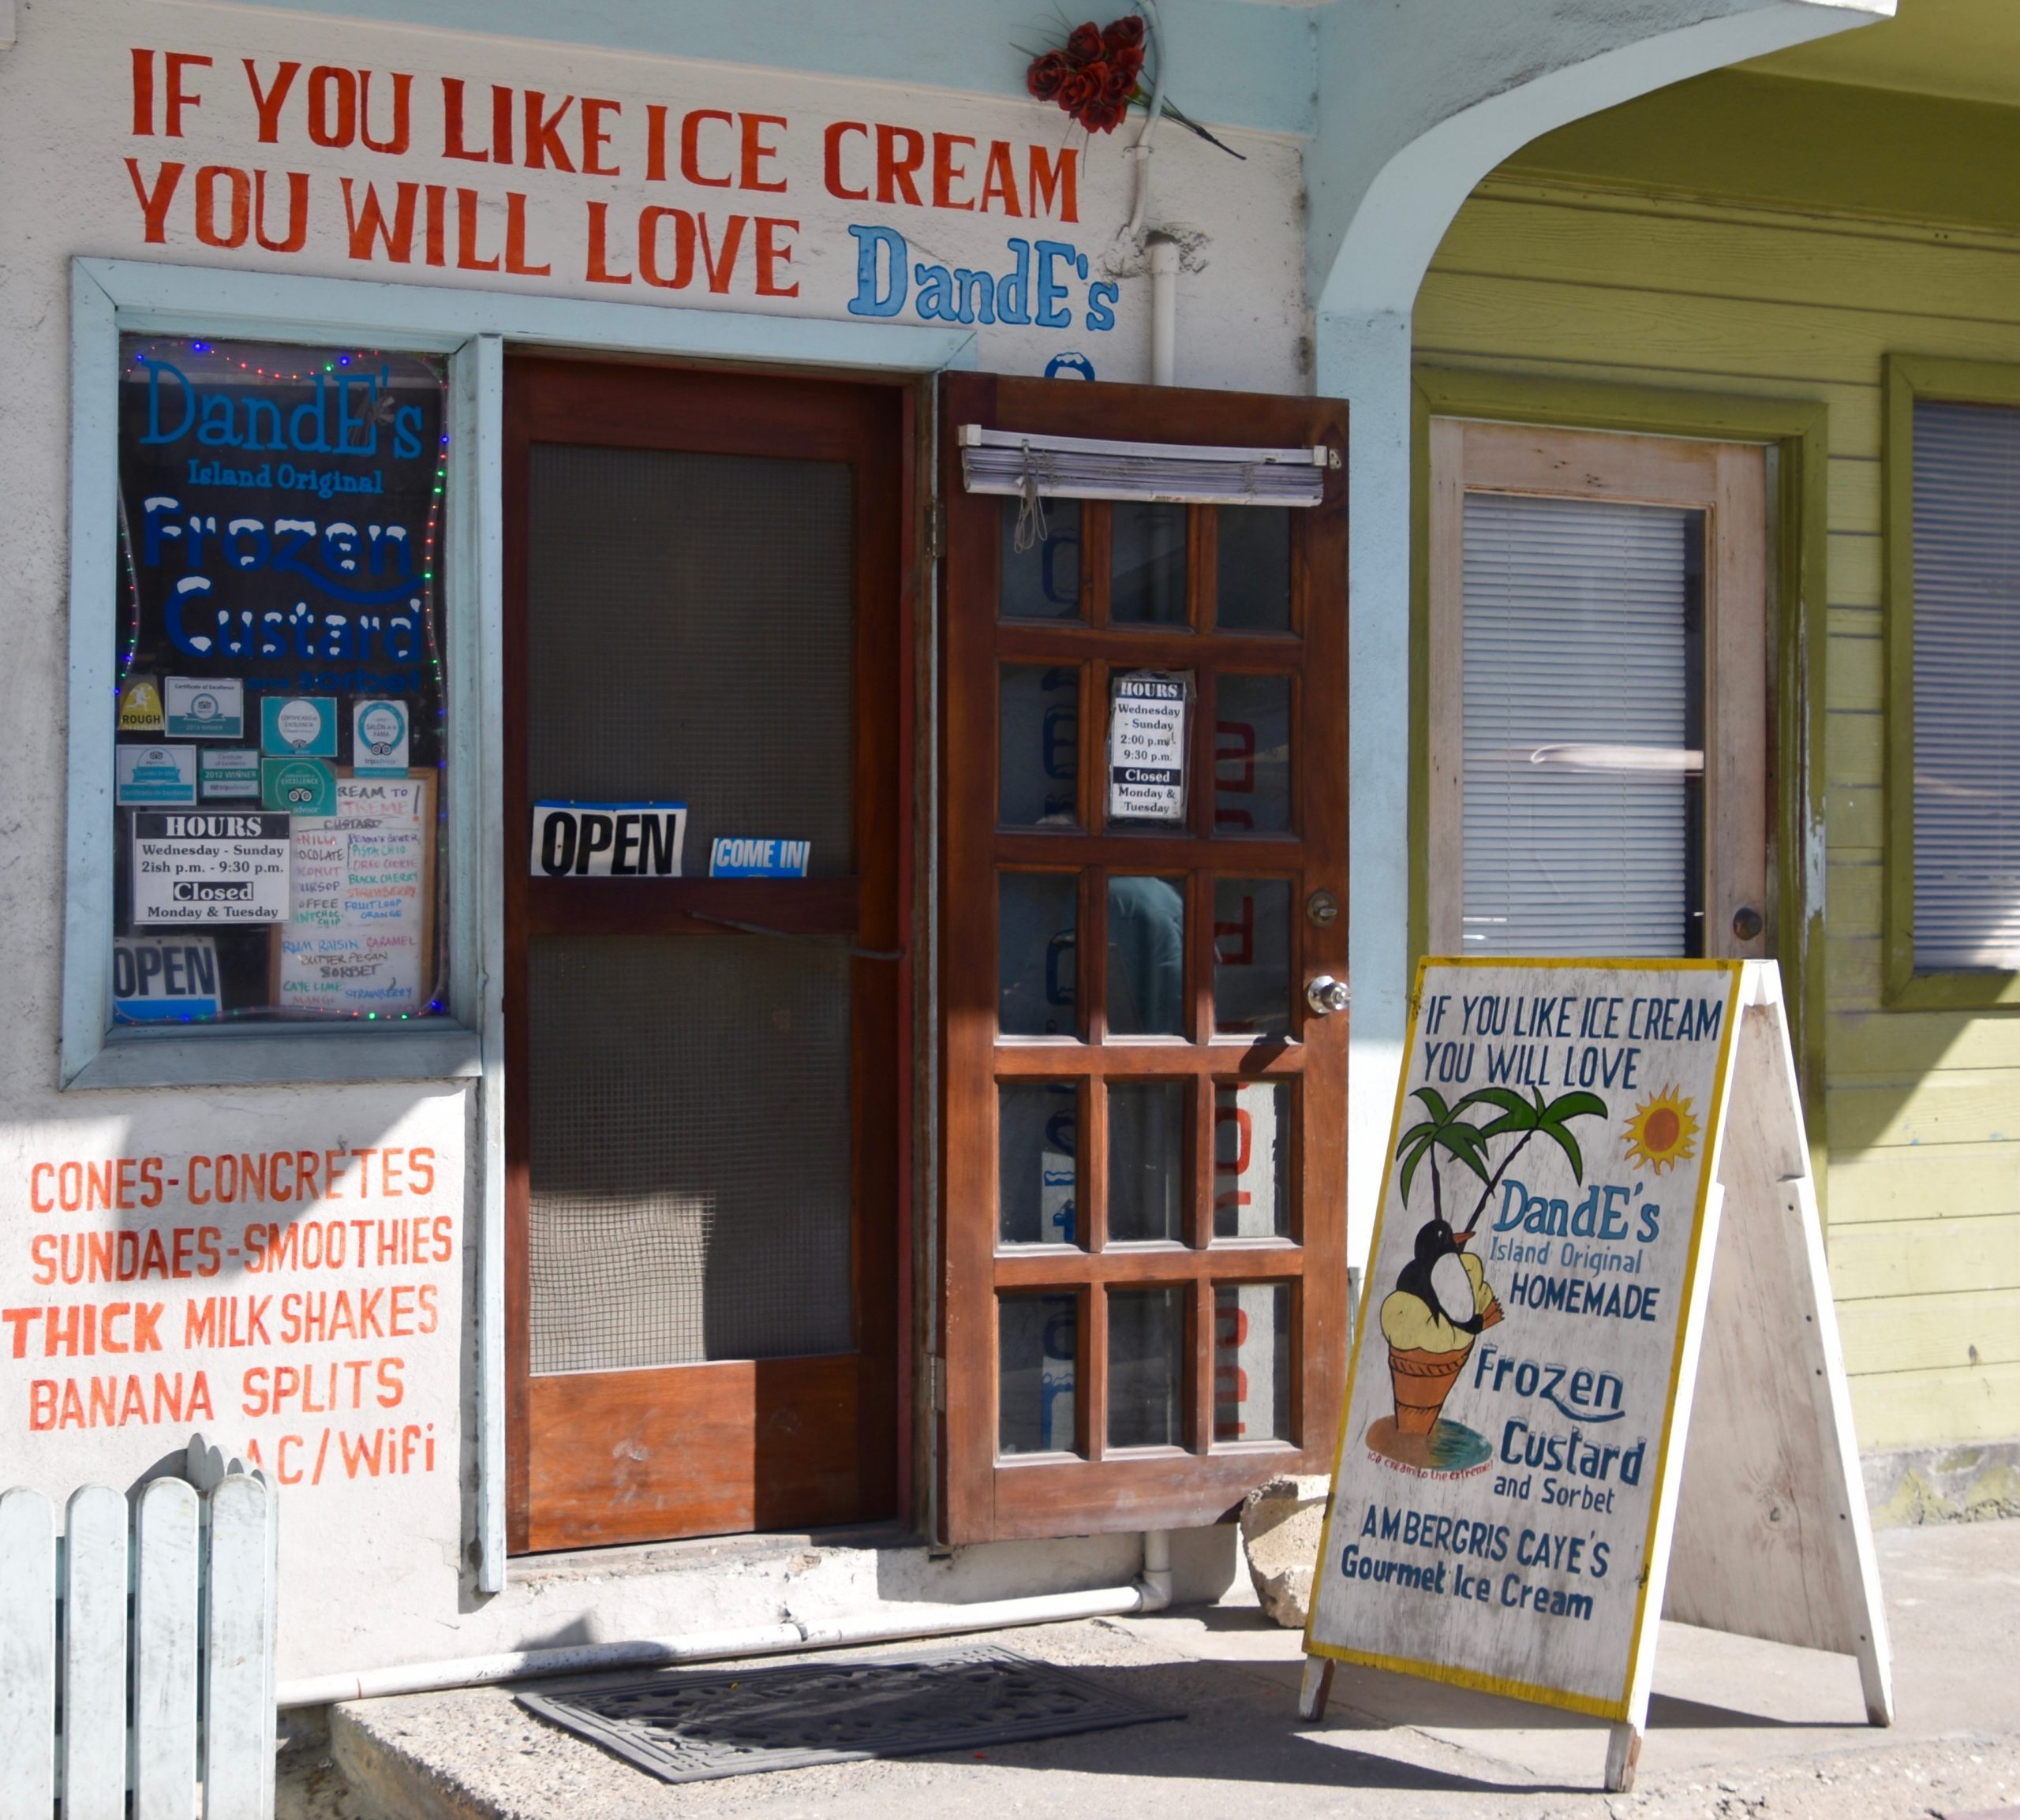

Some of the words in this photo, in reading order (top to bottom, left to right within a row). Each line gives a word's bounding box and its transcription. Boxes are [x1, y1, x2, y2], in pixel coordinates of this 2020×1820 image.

[130, 48, 213, 137] IF
[241, 58, 414, 155] YOU
[441, 77, 621, 177] LIKE
[645, 103, 787, 193] ICE
[823, 121, 1079, 224] CREAM
[123, 157, 310, 253] YOU
[339, 176, 551, 277] WILL
[585, 200, 800, 297] LOVE
[847, 223, 1120, 332] DandE's
[140, 358, 423, 460] DandE's
[188, 459, 273, 488] Island
[278, 463, 383, 499] Original
[144, 496, 425, 604] Frozen
[164, 575, 423, 663] Custard
[1120, 682, 1178, 698] HOURS
[122, 714, 160, 724] ROUGH
[1117, 703, 1180, 718] Wednesday
[1132, 719, 1174, 731] Sunday
[1120, 734, 1144, 745] 2:00
[1124, 749, 1148, 761] 9:30
[1151, 753, 1173, 763] p.m.
[204, 770, 224, 779] 2012
[225, 770, 256, 779] WINNER
[1124, 769, 1171, 783] Closed
[338, 786, 386, 799] REAM
[390, 788, 409, 798] TO
[1118, 785, 1163, 799] Monday
[1166, 790, 1176, 799] &
[1124, 802, 1169, 815] Tuesday
[166, 816, 263, 837] HOURS
[142, 844, 220, 858] Wednesday
[233, 844, 284, 858] Sunday
[297, 833, 337, 846] NILLA
[541, 811, 677, 876] OPEN
[716, 839, 774, 869] COME
[780, 839, 804, 869] IN
[141, 861, 170, 873] 2ish
[175, 864, 206, 876] p.m.
[219, 861, 250, 873] 9:30
[254, 864, 284, 875] p.m.
[173, 882, 253, 901] Closed
[299, 880, 341, 893] URSOP
[148, 906, 203, 920] Monday
[207, 906, 219, 917] &
[224, 906, 279, 918] Tuesday
[317, 917, 341, 926] CHIP
[282, 940, 314, 954] RUM
[318, 940, 359, 953] RAISIN
[366, 936, 418, 948] CARAMEL
[114, 946, 216, 999] OPEN
[320, 963, 383, 978] SORBET
[1426, 996, 1452, 1036] IF
[1463, 996, 1510, 1037] YOU
[1513, 996, 1577, 1038] LIKE
[1580, 996, 1624, 1040] ICE
[1628, 997, 1723, 1041] CREAM
[1424, 1041, 1475, 1083] YOU
[1487, 1044, 1550, 1086] WILL
[1563, 1045, 1641, 1090] LOVE
[1492, 1178, 1660, 1244] DandE's
[1489, 1236, 1550, 1265] Island
[1561, 1241, 1643, 1277] Original
[1509, 1272, 1660, 1323] HOMEMADE
[2, 1302, 166, 1359] THICK
[29, 1370, 215, 1431] BANANA
[241, 1356, 405, 1418] SPLITS
[1474, 1342, 1625, 1423] Frozen
[1500, 1415, 1648, 1486] Custard
[1384, 1459, 1415, 1475] cream
[1416, 1467, 1428, 1481] to
[1431, 1468, 1448, 1482] the
[1494, 1474, 1532, 1500] and
[1541, 1478, 1616, 1515] Sorbet
[1360, 1504, 1510, 1563] AMBERGRIS
[1516, 1530, 1611, 1579] CAYE'S
[1341, 1544, 1445, 1595] Gourmet
[1453, 1564, 1491, 1603] Ice
[1501, 1573, 1594, 1621] Cream
